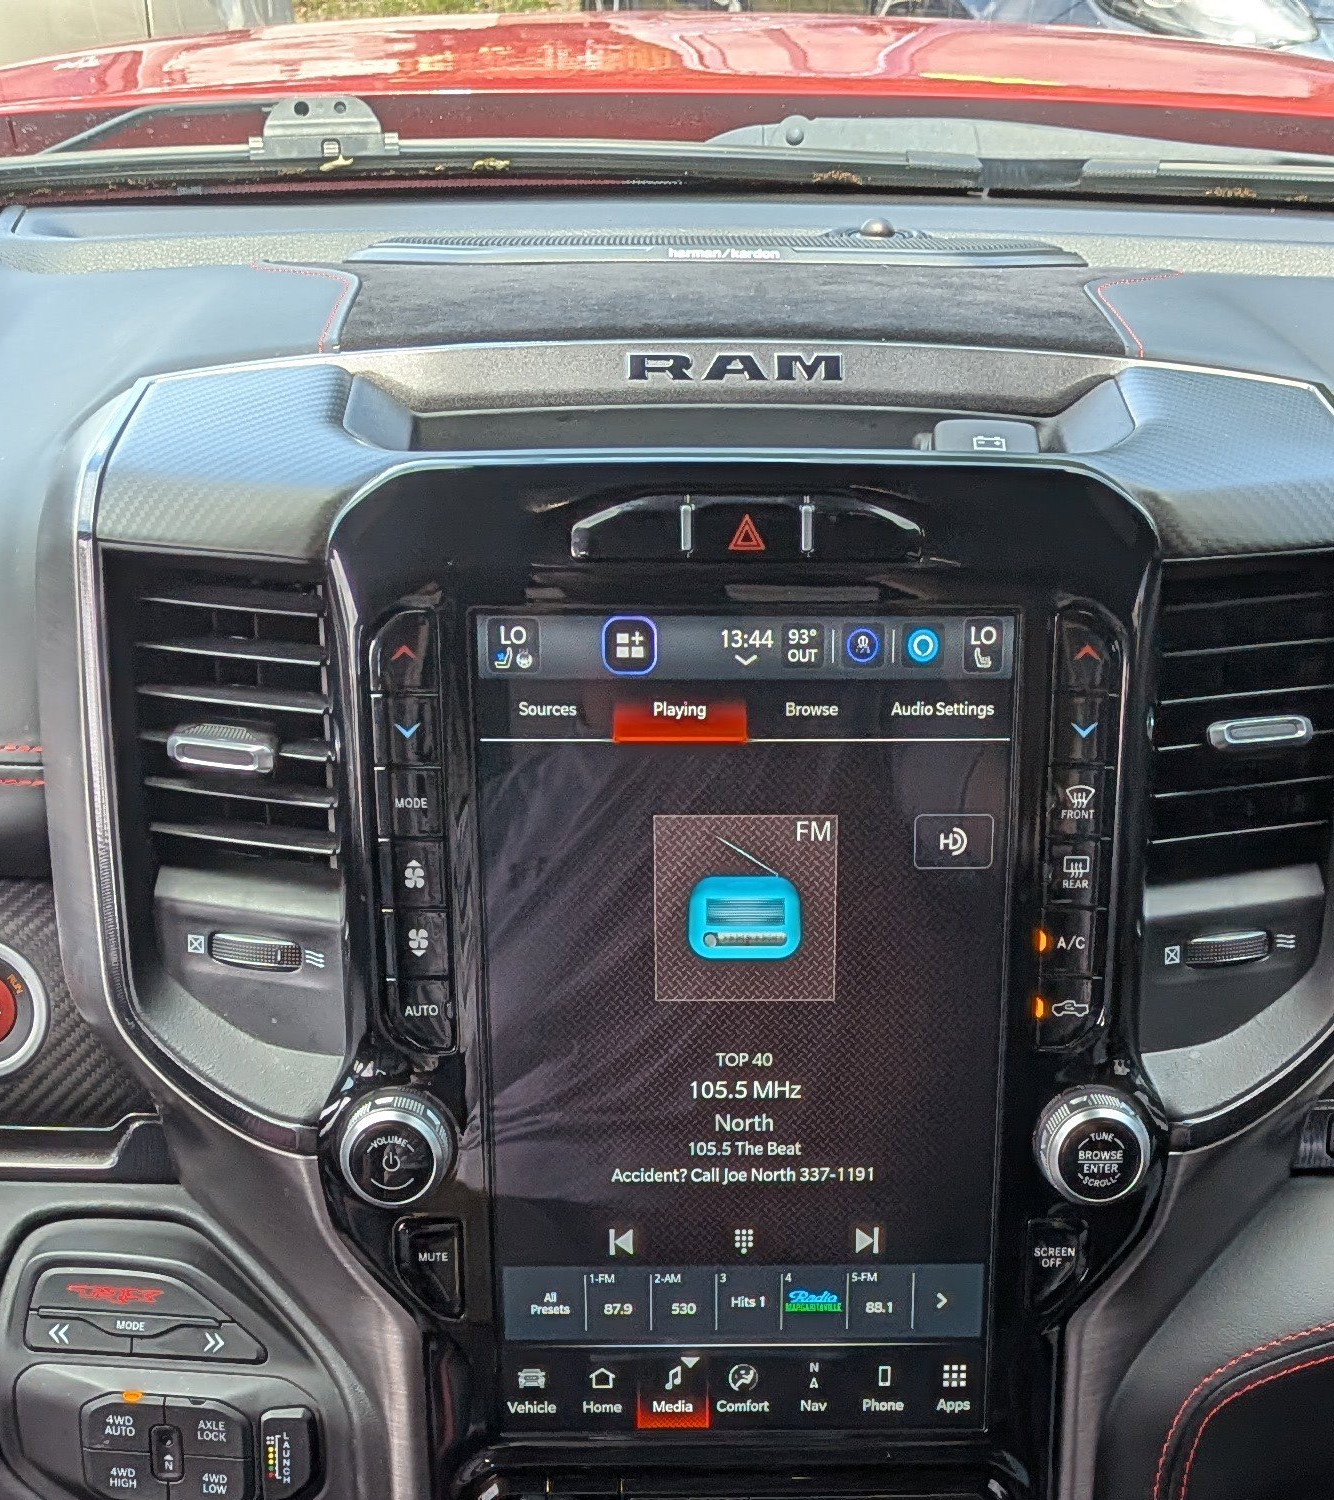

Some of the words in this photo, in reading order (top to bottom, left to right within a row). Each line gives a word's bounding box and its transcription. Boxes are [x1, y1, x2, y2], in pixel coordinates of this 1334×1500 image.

[668, 247, 781, 259] harman/kardon
[627, 352, 844, 381] RAM
[499, 626, 526, 645] LO
[720, 629, 774, 648] 13:44
[787, 629, 817, 645] 93°
[969, 626, 997, 645] LO
[787, 648, 818, 663] OUT
[518, 701, 577, 717] Sources
[652, 701, 708, 720] Playing
[785, 701, 839, 717] Browse
[890, 700, 936, 717] Audio
[938, 700, 995, 721] Settings
[395, 797, 429, 810] MODE
[1061, 809, 1095, 820] FRONT
[795, 821, 832, 842] FM
[1062, 879, 1089, 889] REAR
[1057, 935, 1086, 950] A/C
[6, 973, 26, 995] RUN
[404, 1004, 439, 1017] AUTO
[716, 1052, 748, 1067] TOP
[752, 1052, 773, 1067] 40
[689, 1080, 747, 1099] 105.5
[753, 1080, 802, 1099] MHz
[715, 1114, 774, 1132] North
[370, 1135, 408, 1148] VOLUME
[1089, 1131, 1115, 1142] TUNE
[688, 1141, 731, 1156] 105.5
[735, 1141, 763, 1156] The
[767, 1141, 802, 1156] Beat
[1078, 1150, 1124, 1160] BROWSE
[611, 1168, 688, 1183] Accident?
[690, 1167, 720, 1182] Call
[723, 1167, 747, 1182] Joe
[751, 1167, 796, 1182] North
[799, 1166, 874, 1182] 337-1191
[1083, 1163, 1118, 1174] ENTER
[1082, 1175, 1118, 1188] SCROLL
[418, 1252, 449, 1262] MUTE
[1034, 1247, 1076, 1257] SCREEN
[1041, 1258, 1063, 1268] OFF
[589, 1274, 615, 1284] 1-FM
[654, 1274, 681, 1284] 2-AM
[720, 1273, 727, 1283] 3
[785, 1273, 792, 1282] 4
[851, 1272, 878, 1282] 5-FM
[543, 1292, 557, 1303] All
[730, 1295, 756, 1308] Hits
[789, 1290, 838, 1303] Radio
[530, 1303, 571, 1315] Presets
[603, 1303, 633, 1315] 87.9
[671, 1302, 697, 1315] 530
[865, 1301, 893, 1313] 88.1
[116, 1320, 145, 1331] MODE
[507, 1400, 557, 1414] Vehicle
[582, 1401, 623, 1413] Home
[652, 1400, 694, 1413] Media
[716, 1399, 769, 1413] Comfort
[800, 1400, 827, 1412] Nav
[862, 1399, 905, 1412] Phone
[936, 1399, 971, 1415] Apps
[105, 1415, 133, 1425] 4WD
[198, 1420, 226, 1431] AXLE
[105, 1426, 135, 1436] AUTO
[197, 1432, 227, 1442] LOCK
[110, 1468, 135, 1478] 4WD
[202, 1474, 227, 1484] 4WD
[109, 1478, 137, 1488] HIGH
[202, 1484, 227, 1494] LOW
